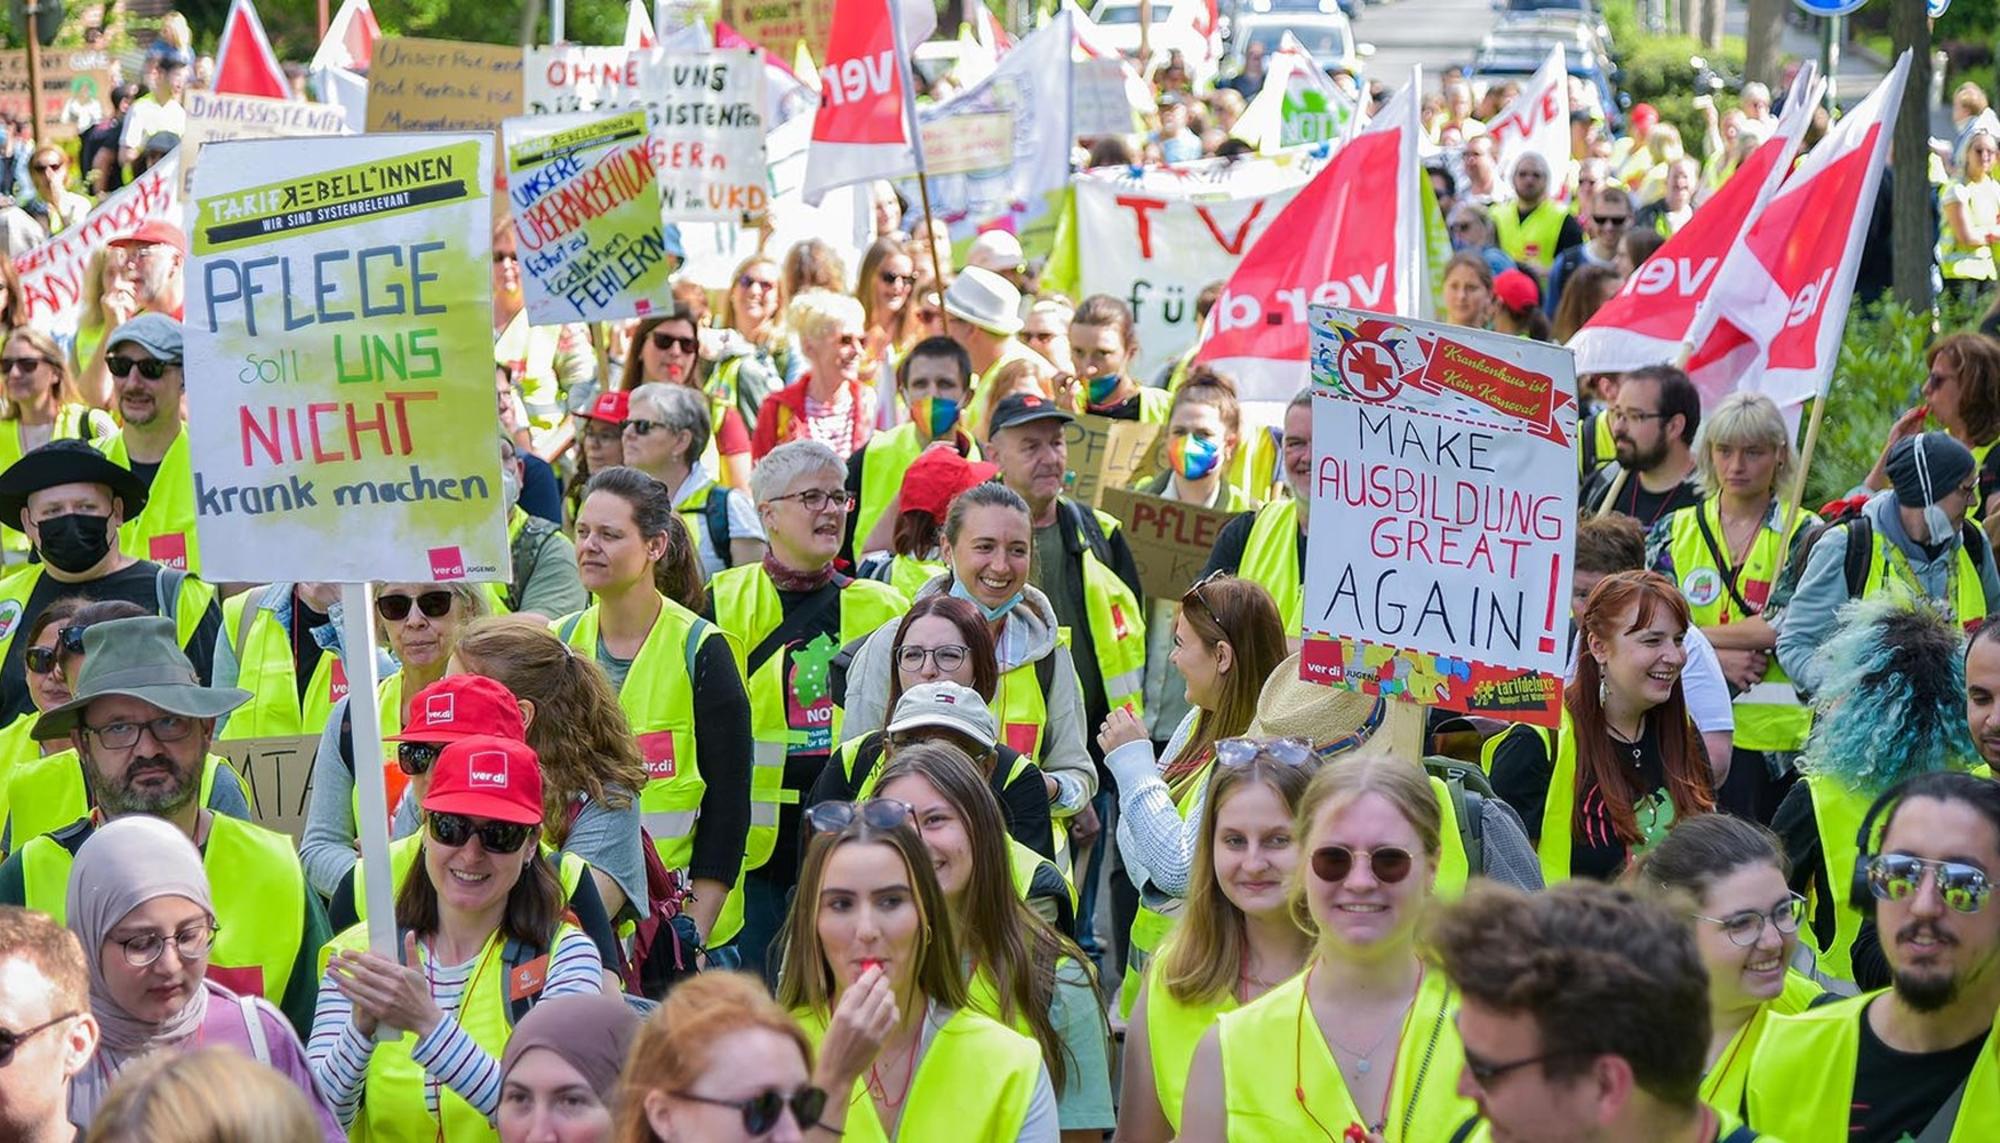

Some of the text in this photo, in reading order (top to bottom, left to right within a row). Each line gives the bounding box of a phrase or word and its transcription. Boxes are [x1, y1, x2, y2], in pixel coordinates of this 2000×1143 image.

[547, 60, 728, 91] OHNE UNS
[512, 150, 585, 208] UNSERE
[708, 183, 767, 210] UKD
[262, 192, 410, 233] WIR SIND SYSTEMRELEVANT
[204, 240, 448, 337] PFLEGE
[566, 225, 665, 317] FEHLERN
[334, 328, 442, 384] UNS
[1443, 368, 1476, 394] Kein
[239, 391, 438, 467] NICHT
[1359, 407, 1496, 473] MAKE
[193, 465, 489, 516] krank machen
[1319, 456, 1563, 541] AUSBILDUNG
[1370, 516, 1533, 579] GREAT
[1346, 670, 1382, 682] JUGEND
